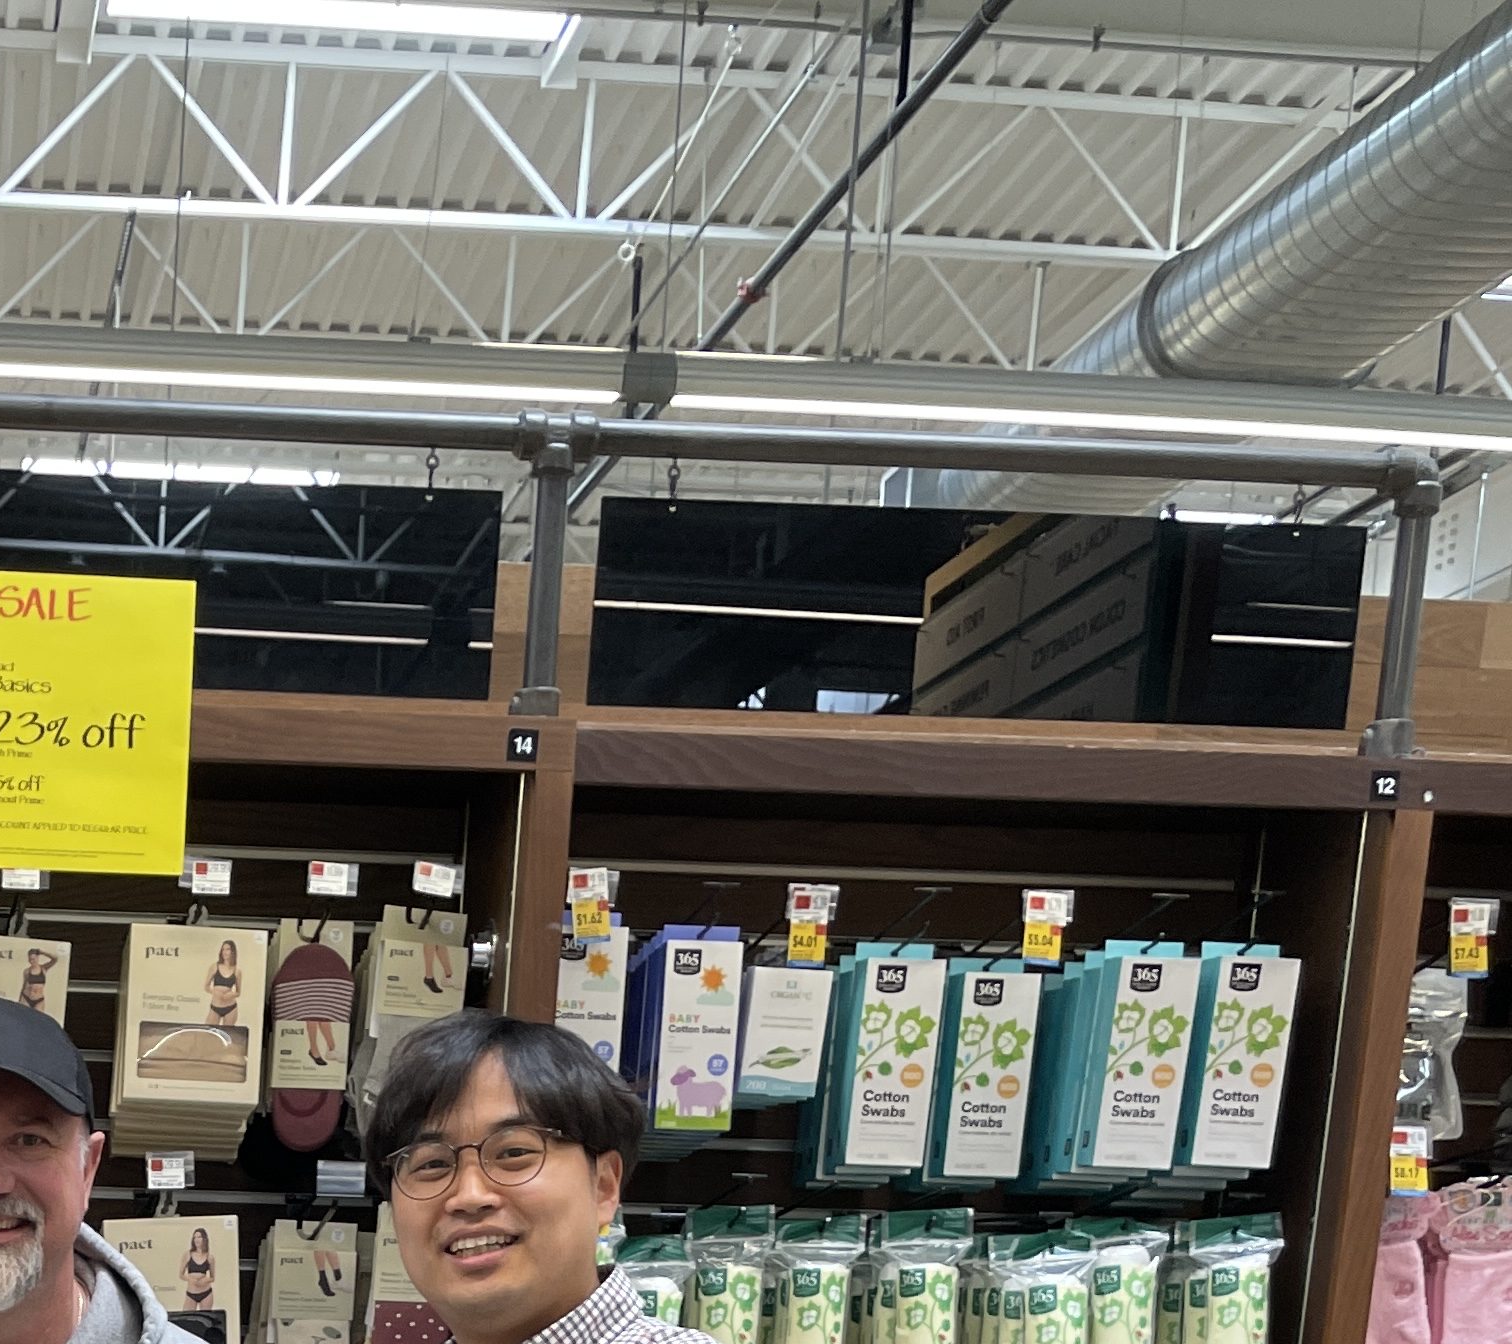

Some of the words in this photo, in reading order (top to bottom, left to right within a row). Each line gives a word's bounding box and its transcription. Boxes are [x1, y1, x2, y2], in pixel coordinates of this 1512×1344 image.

[82, 713, 146, 749] off
[513, 736, 533, 755] 14
[7, 749, 33, 758] Prime
[18, 775, 44, 791] off
[1376, 777, 1396, 795] 12
[19, 796, 45, 805] Prime
[32, 822, 67, 832] APPLIED
[70, 823, 81, 831] TO
[123, 826, 147, 835] PRICE
[575, 911, 603, 927] $1.62
[792, 934, 818, 949] $4.01
[144, 945, 180, 959] pact
[389, 946, 414, 958] pact
[675, 951, 700, 966] 365
[878, 967, 904, 984] 365
[1131, 966, 1159, 983] 365
[1231, 966, 1258, 982] 365
[975, 981, 1002, 997] 365
[668, 1013, 701, 1024] BABY
[279, 1025, 305, 1037] pact
[668, 1024, 700, 1034] Cotton
[701, 1025, 731, 1035] Swabs
[863, 1089, 910, 1103] Cotton
[1113, 1090, 1161, 1104] Cotton
[1212, 1088, 1260, 1103] Cotton
[861, 1104, 906, 1118] Swabs
[961, 1101, 1007, 1114] Cotton
[1111, 1105, 1156, 1118] Swabs
[1210, 1103, 1256, 1118] Swabs
[960, 1115, 1003, 1128] Swabs
[118, 1238, 153, 1253] pact
[280, 1255, 304, 1266] pact
[795, 1273, 819, 1287] 365
[1095, 1270, 1118, 1284] 365
[1212, 1270, 1237, 1285] 365
[1029, 1288, 1055, 1303] 365
